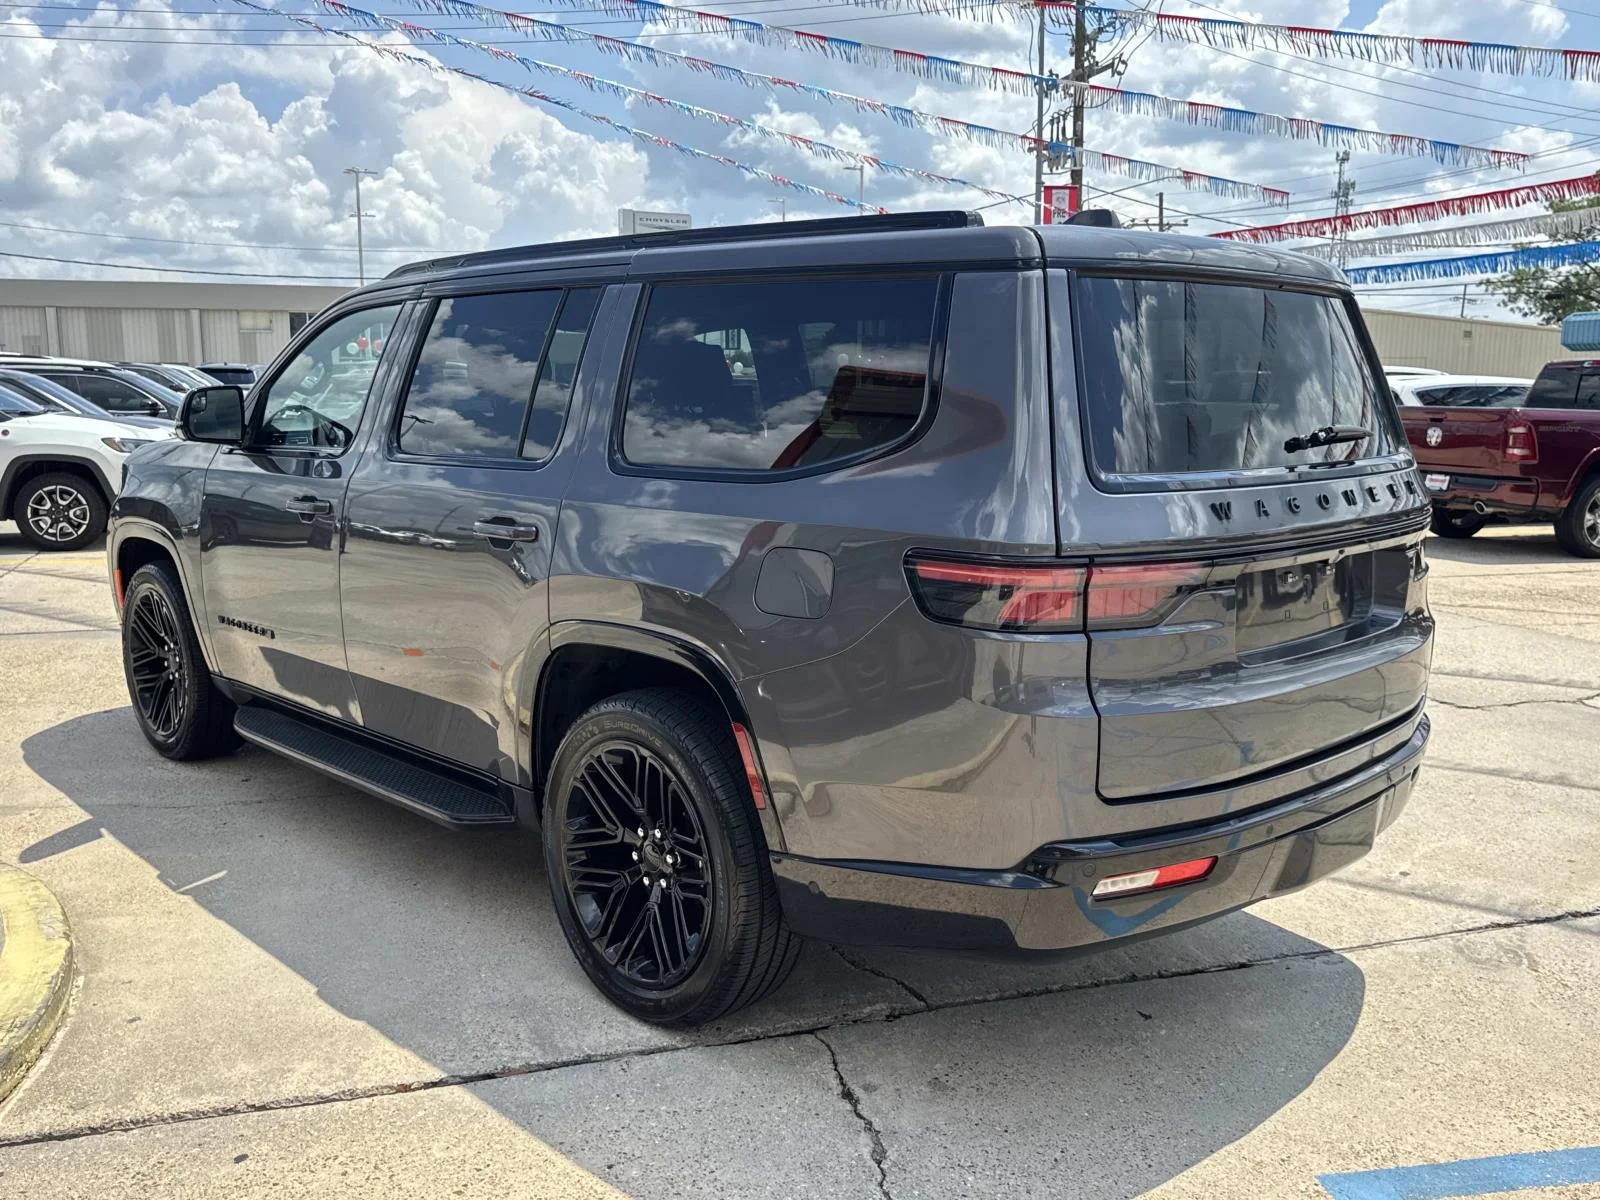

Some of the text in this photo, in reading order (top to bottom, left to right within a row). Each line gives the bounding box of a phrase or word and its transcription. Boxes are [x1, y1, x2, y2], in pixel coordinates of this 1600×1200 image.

[639, 216, 688, 225] CHRYSLER
[1209, 479, 1418, 521] WAGONEER
[217, 614, 267, 637] WAGONEER
